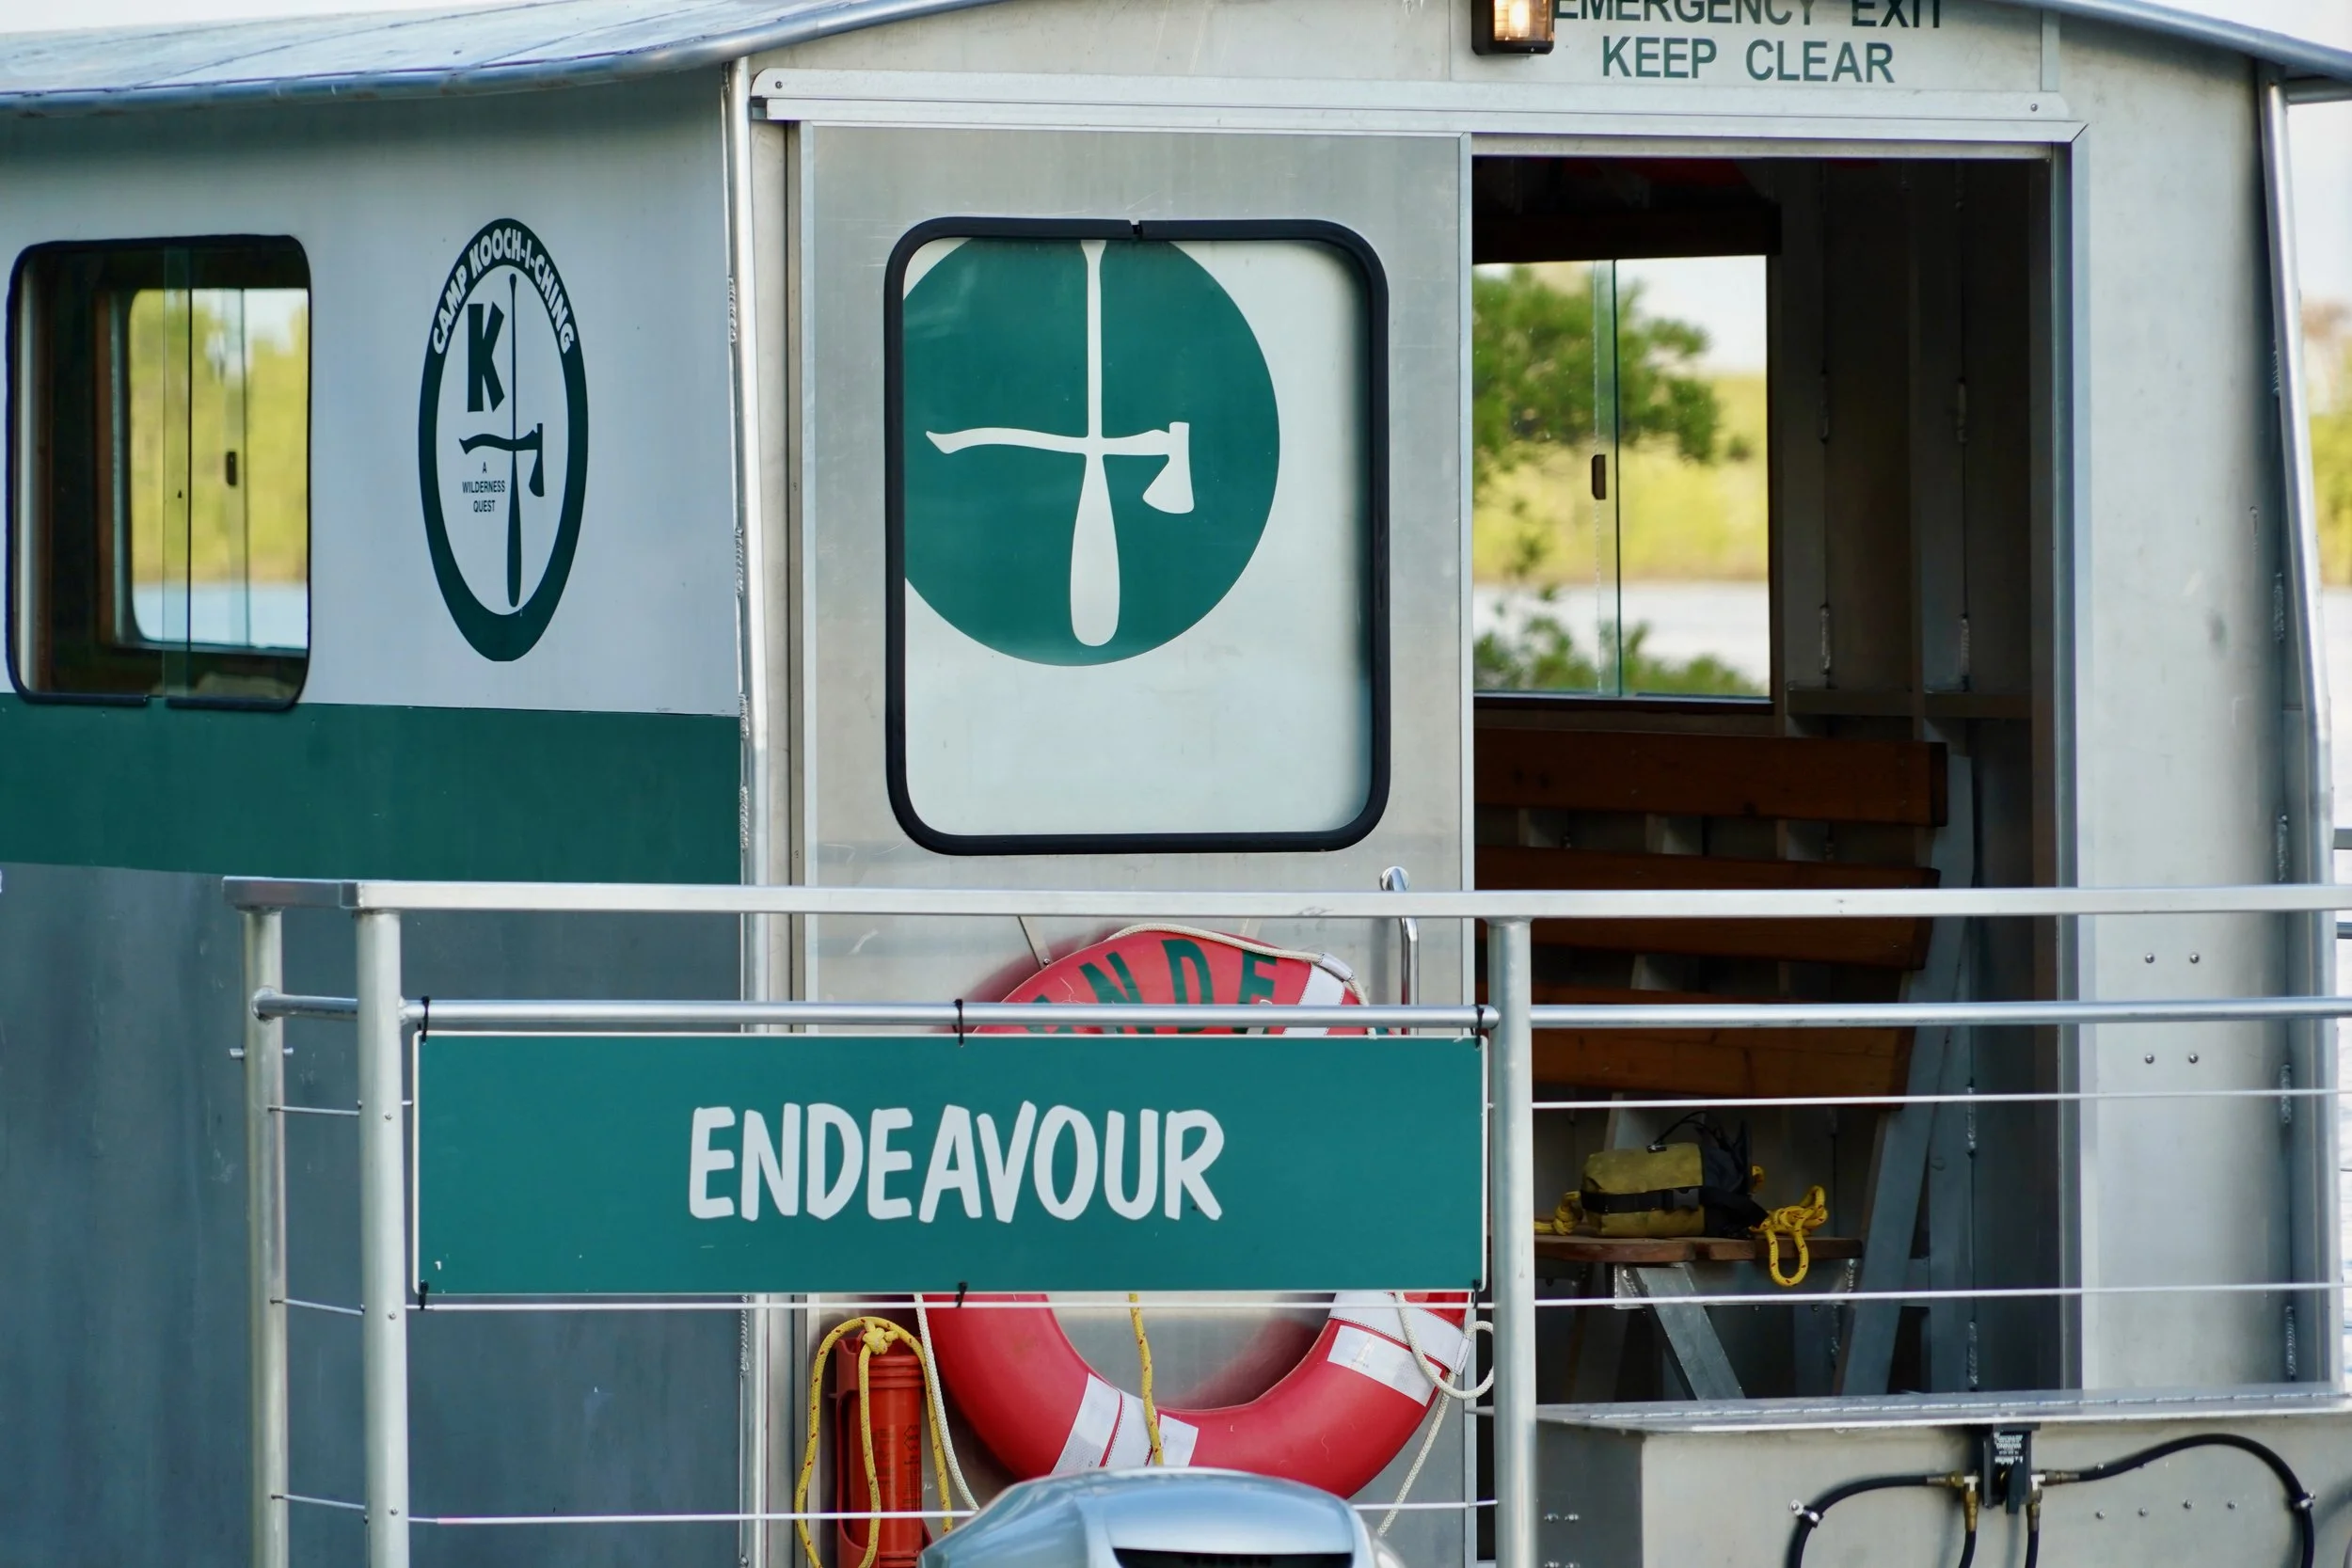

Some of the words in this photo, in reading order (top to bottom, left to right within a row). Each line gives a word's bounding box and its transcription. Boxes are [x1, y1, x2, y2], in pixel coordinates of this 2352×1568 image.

[1851, 0, 1940, 28] EXIT
[1602, 36, 1717, 79] KEEP
[1745, 39, 1895, 84] CLEAR
[433, 264, 468, 355] CAMP
[469, 227, 575, 355] KOOCH-I-CHING
[467, 301, 505, 413] K
[482, 461, 487, 474] A
[462, 480, 506, 494] WILDERNESS
[472, 499, 496, 513] QUEST
[689, 1100, 1225, 1224] ENDEAVOUR
